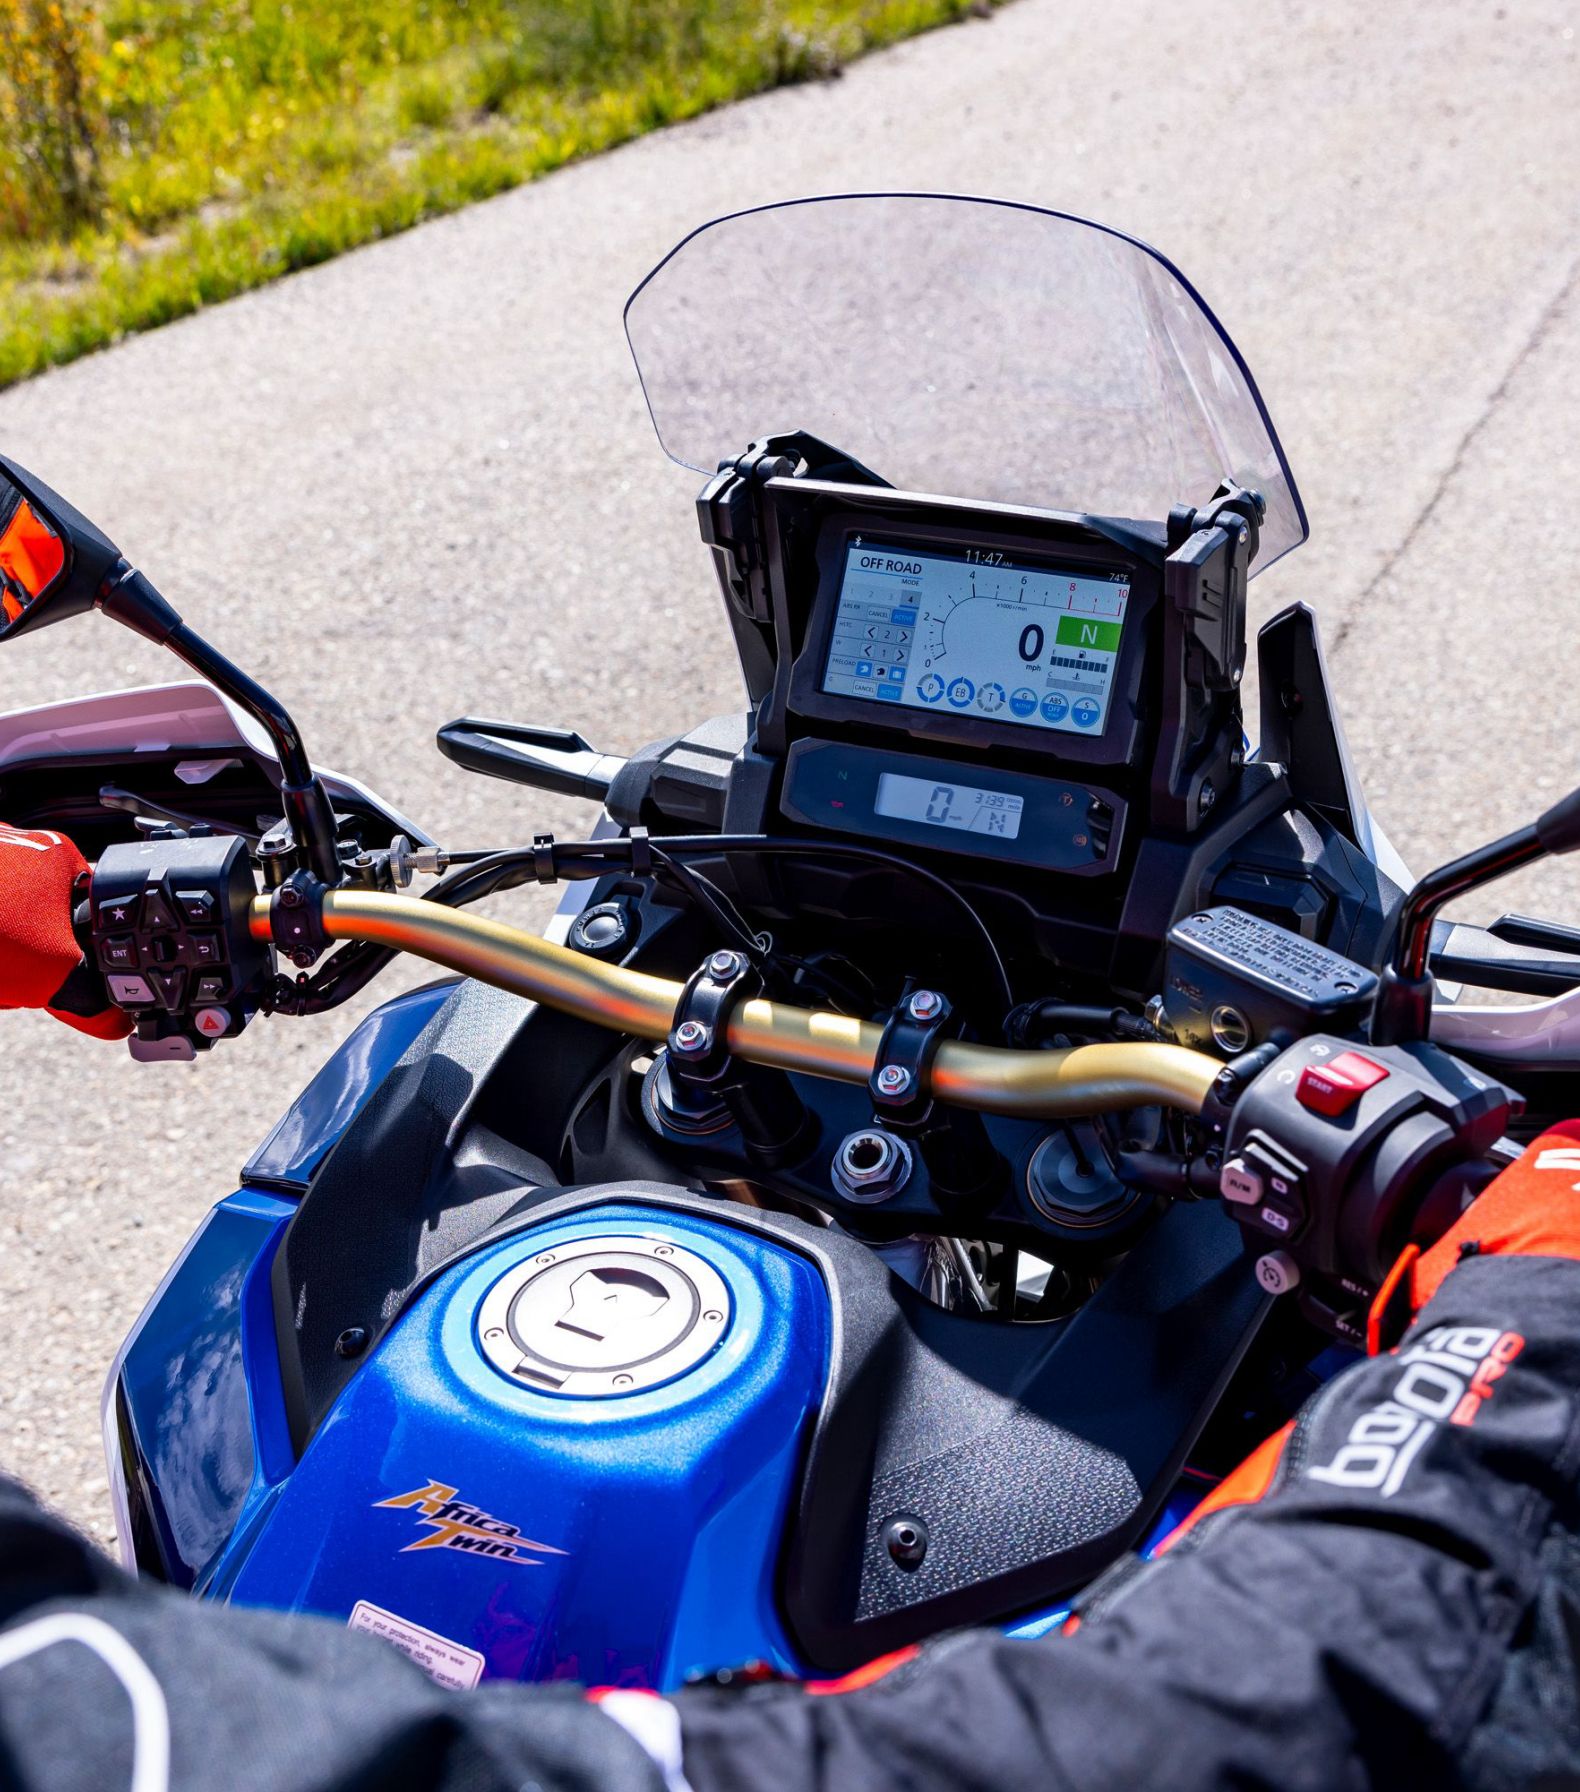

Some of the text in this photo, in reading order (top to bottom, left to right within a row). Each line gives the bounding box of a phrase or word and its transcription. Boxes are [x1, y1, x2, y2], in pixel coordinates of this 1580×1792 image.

[966, 550, 1003, 566] 11:47
[860, 556, 922, 574] OFF ROAD
[1109, 573, 1128, 582] 74°F
[969, 570, 1128, 598] 4 6 8 10
[868, 610, 888, 618] CANCEL
[924, 612, 930, 620] 2
[884, 630, 890, 639] 2
[1018, 624, 1098, 662] 0 N
[925, 659, 931, 668] 0
[1026, 664, 1042, 672] mph
[855, 684, 874, 693] CANCEL
[928, 683, 934, 692] P
[955, 688, 966, 697] EB
[988, 693, 994, 702] T
[926, 786, 954, 823] 0
[988, 812, 1006, 833] N
[112, 949, 127, 958] ENT
[1307, 1077, 1333, 1094] START
[1336, 1320, 1350, 1331] SET
[1449, 1331, 1525, 1428] PRO
[371, 1478, 520, 1538] Africa
[398, 1518, 571, 1565] Twin
[360, 1612, 371, 1623] For
[373, 1621, 388, 1630] your
[425, 1644, 446, 1658] always
[450, 1656, 465, 1666] wear
